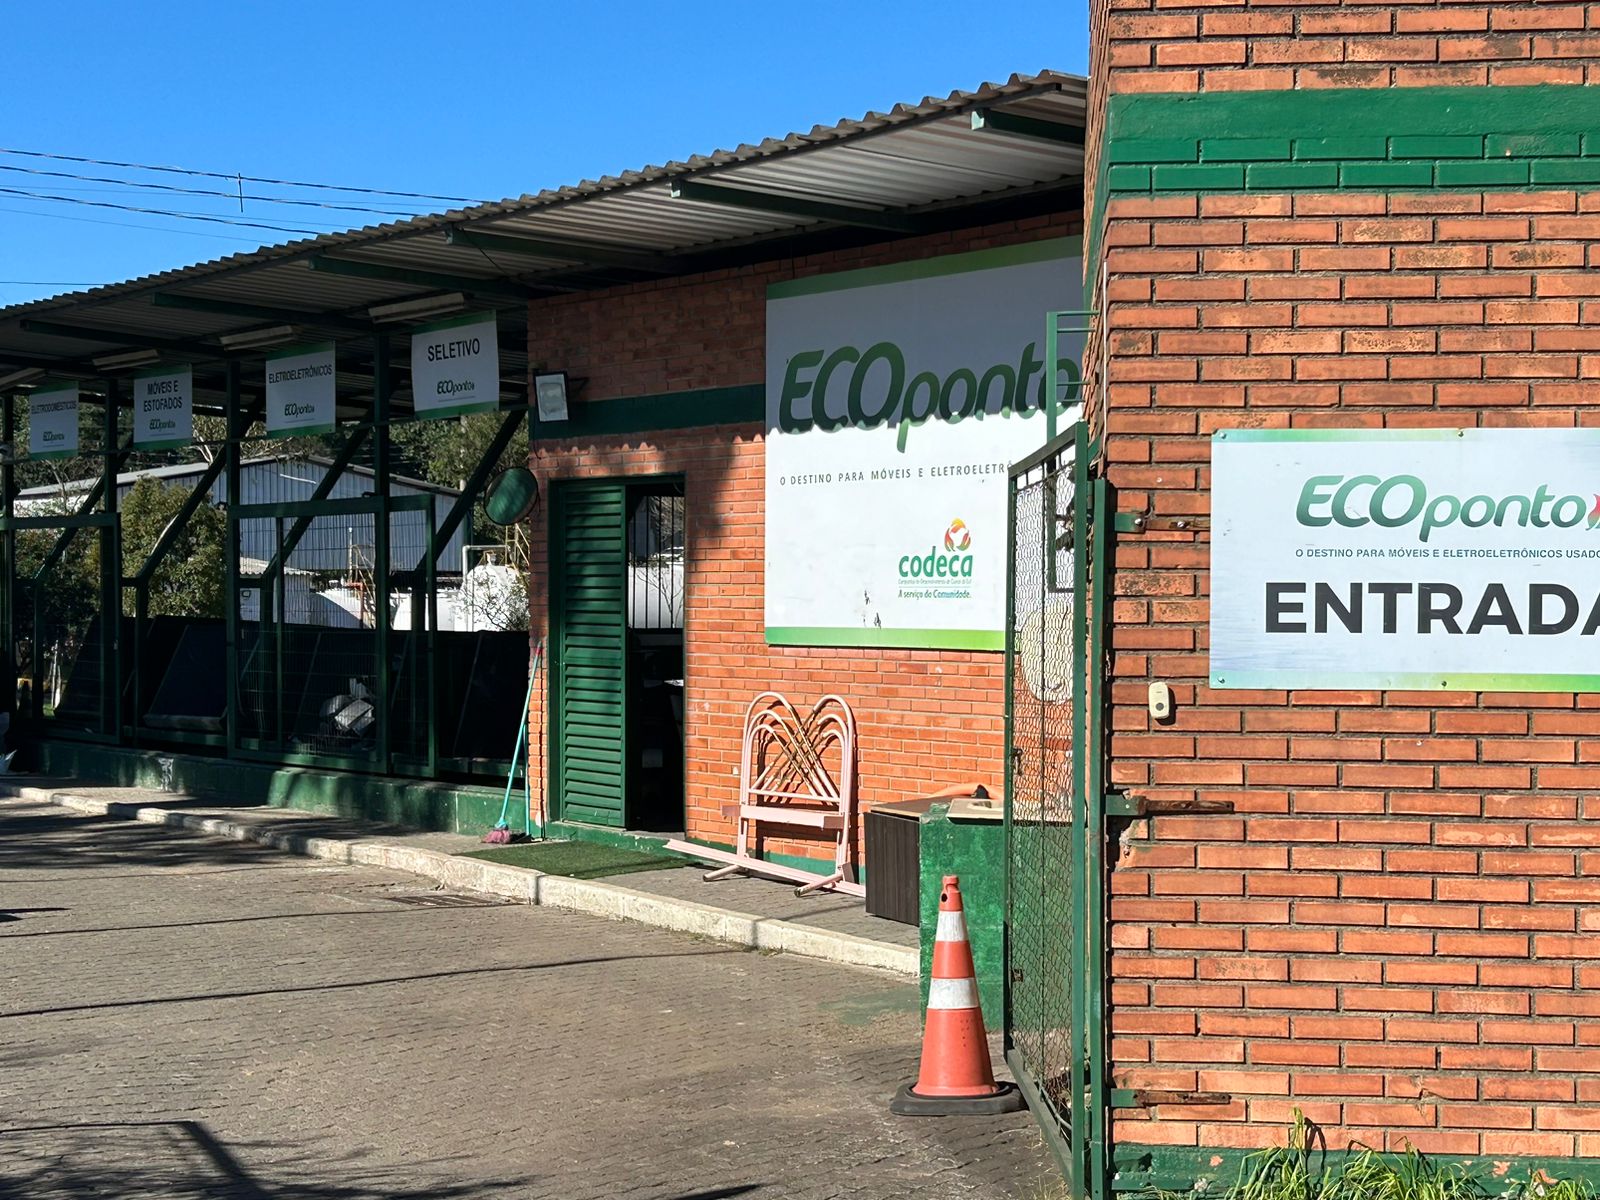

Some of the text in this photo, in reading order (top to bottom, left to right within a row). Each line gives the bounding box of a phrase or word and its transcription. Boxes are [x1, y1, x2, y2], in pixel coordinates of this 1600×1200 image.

[428, 338, 480, 362] SELETIVO
[147, 380, 178, 395] MÓVEIS E
[778, 341, 1079, 453] ECOponto
[144, 396, 182, 412] ESTOFADOS
[780, 475, 786, 485] O
[791, 472, 832, 485] DESTINO
[838, 470, 864, 482] PARA
[871, 466, 911, 480] MÓVEIS
[918, 467, 923, 477] E
[1296, 474, 1586, 543] ECOponto
[899, 545, 973, 577] codeca
[1296, 549, 1303, 558] O
[1307, 548, 1353, 558] DESTINO
[1357, 548, 1385, 558] PARA
[1388, 547, 1429, 558] MÓVEIS
[1433, 549, 1440, 558] E
[1443, 547, 1563, 559] ELETROELETRÔNICOS
